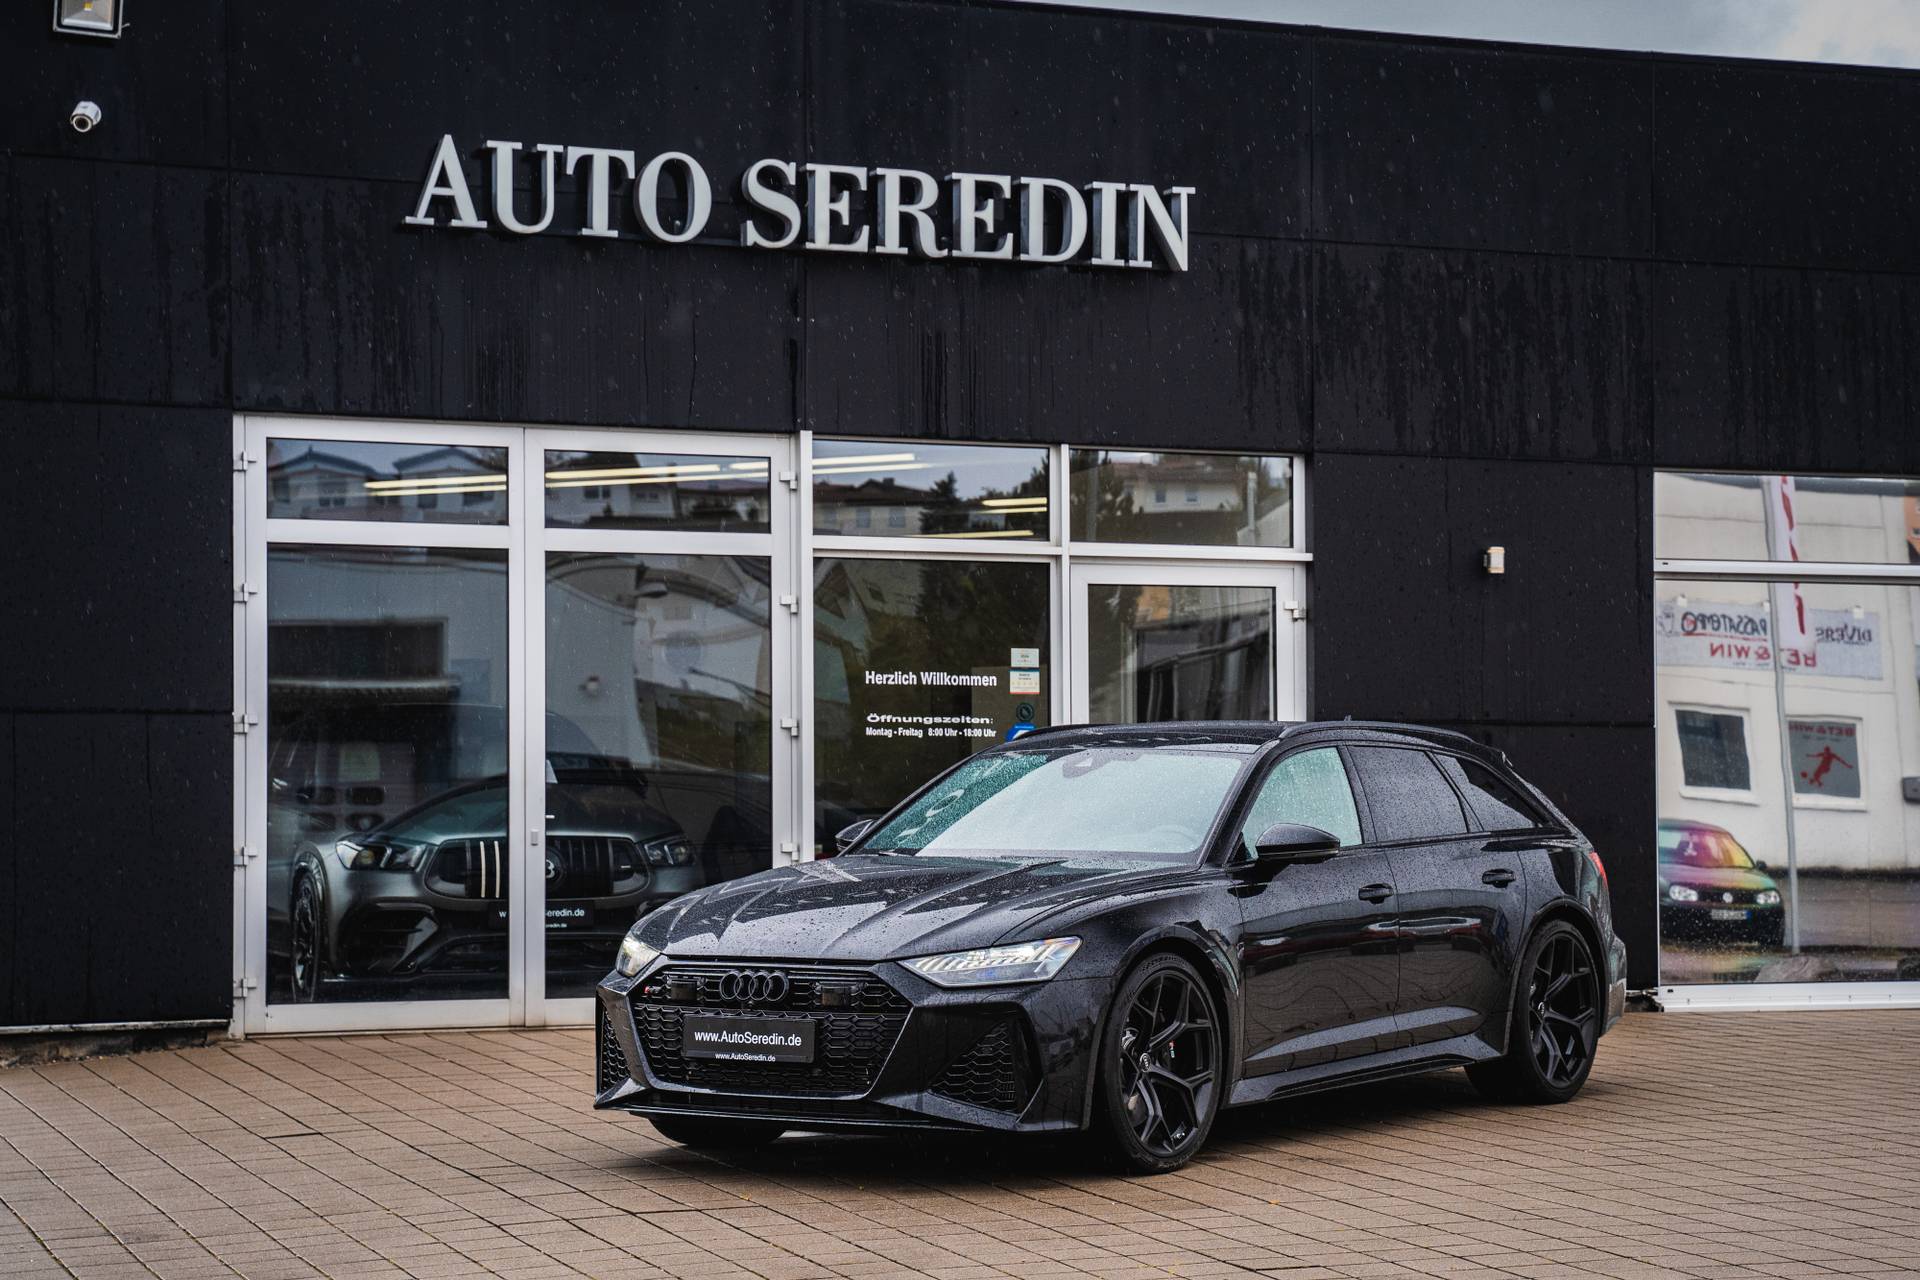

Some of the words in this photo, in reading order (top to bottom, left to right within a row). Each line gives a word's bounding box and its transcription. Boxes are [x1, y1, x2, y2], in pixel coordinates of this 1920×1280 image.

[404, 133, 711, 244] AUTO
[740, 157, 1196, 272] SEREDIN
[865, 670, 917, 685] Herzlich
[920, 671, 998, 687] Willkommen
[866, 712, 994, 725] Öffnungszeiten:
[866, 727, 893, 738] Montag
[898, 727, 923, 738] Freitag
[928, 727, 943, 737] 8:00
[944, 727, 958, 737] Uhr
[963, 728, 983, 737] 18:00
[983, 728, 997, 737] Uhr
[694, 1030, 802, 1046] www.AutoSeredin.de
[715, 1052, 776, 1063] www.AutoSeredin.de
